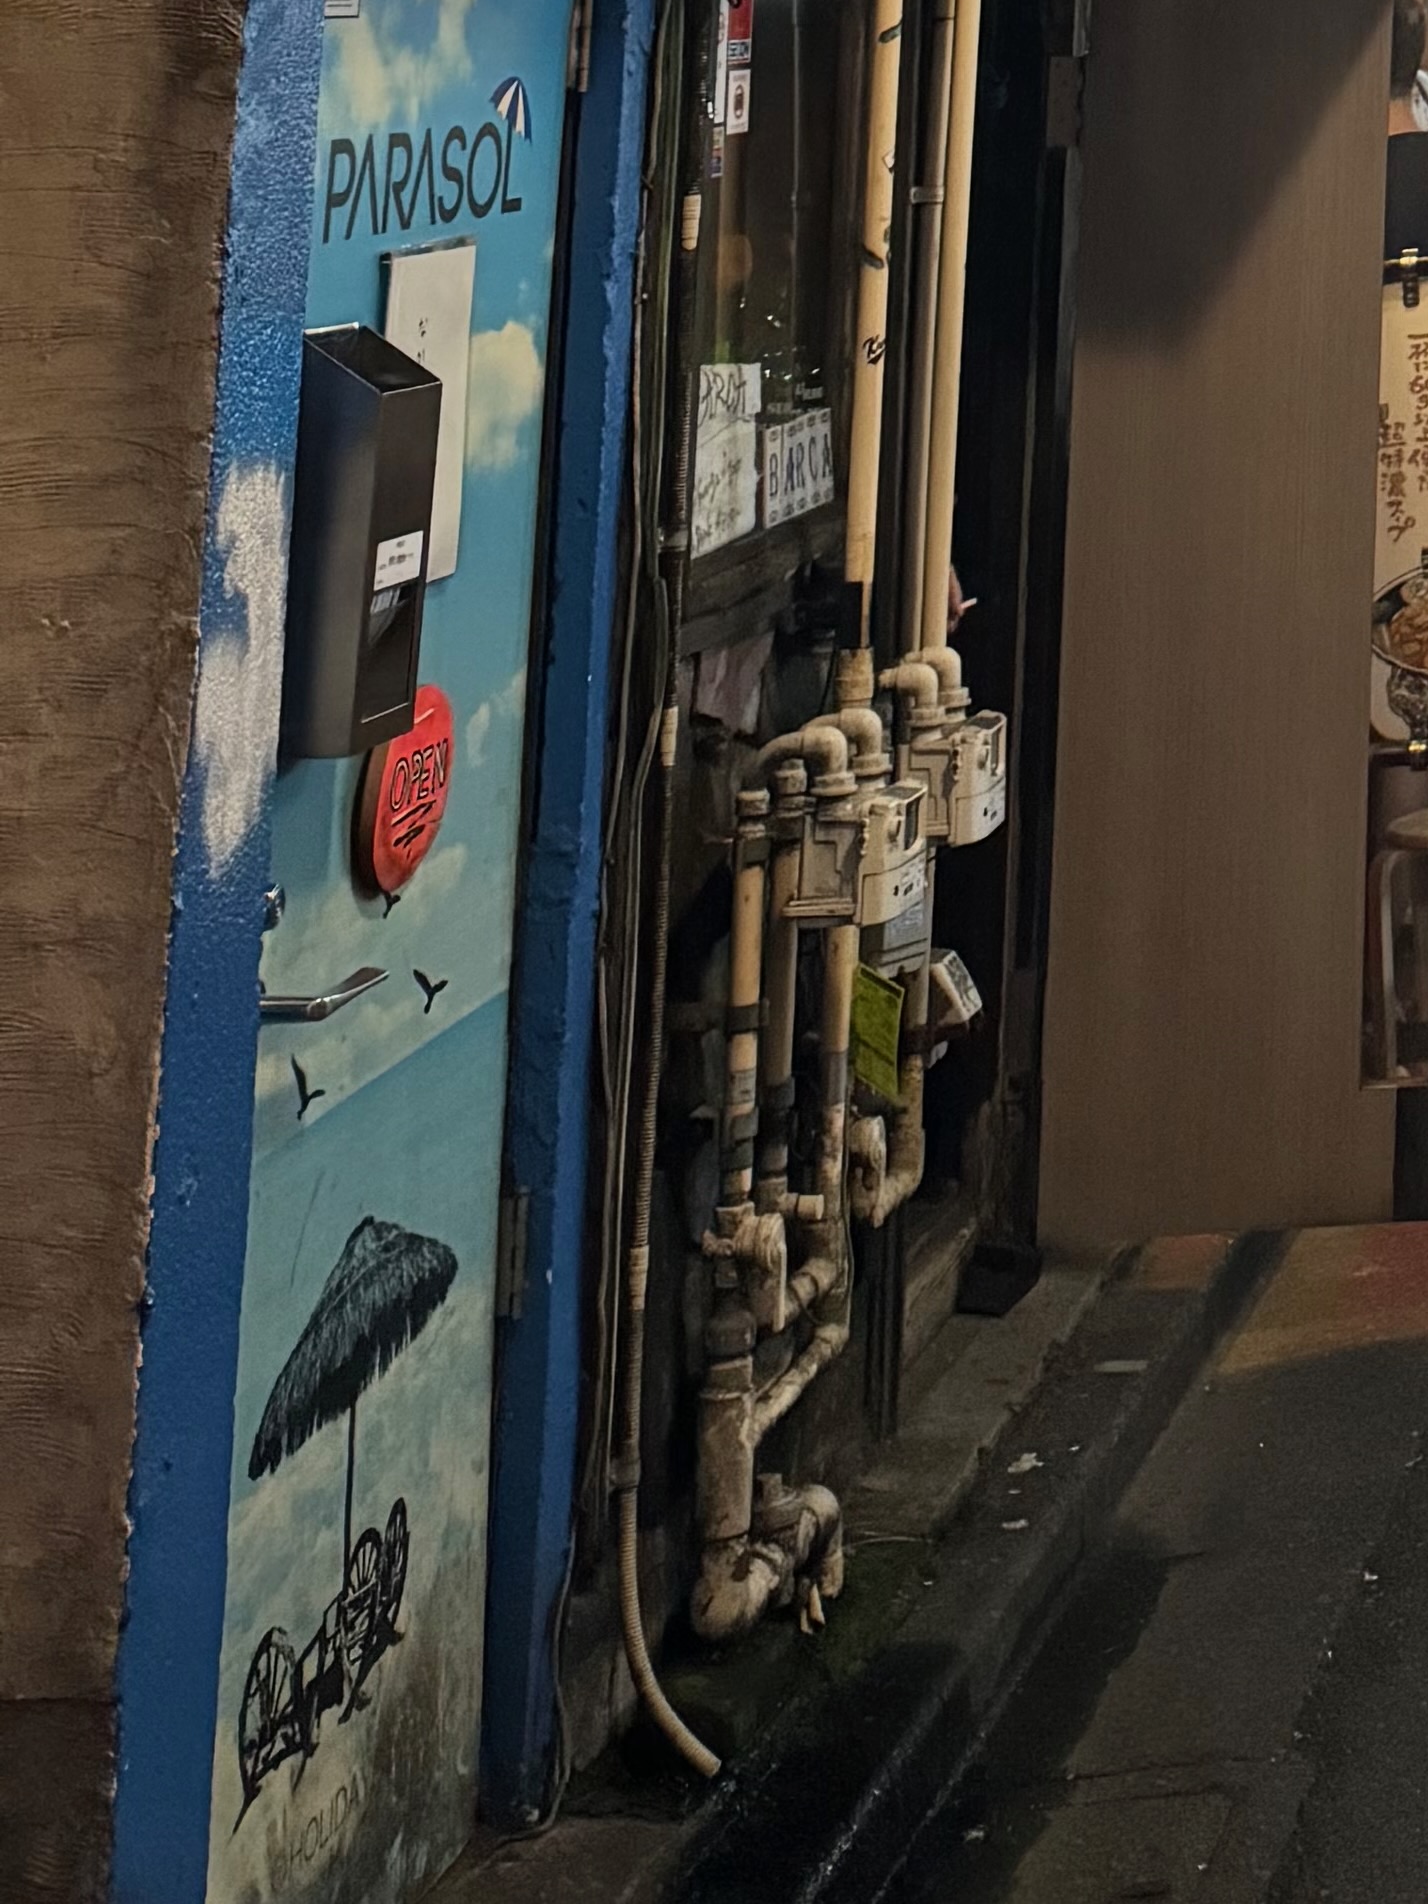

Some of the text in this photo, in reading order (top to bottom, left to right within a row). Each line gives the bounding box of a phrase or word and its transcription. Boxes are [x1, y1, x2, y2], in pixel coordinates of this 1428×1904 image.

[322, 125, 524, 245] PARASOL
[769, 433, 833, 497] BARCA
[389, 737, 449, 813] OPEN
